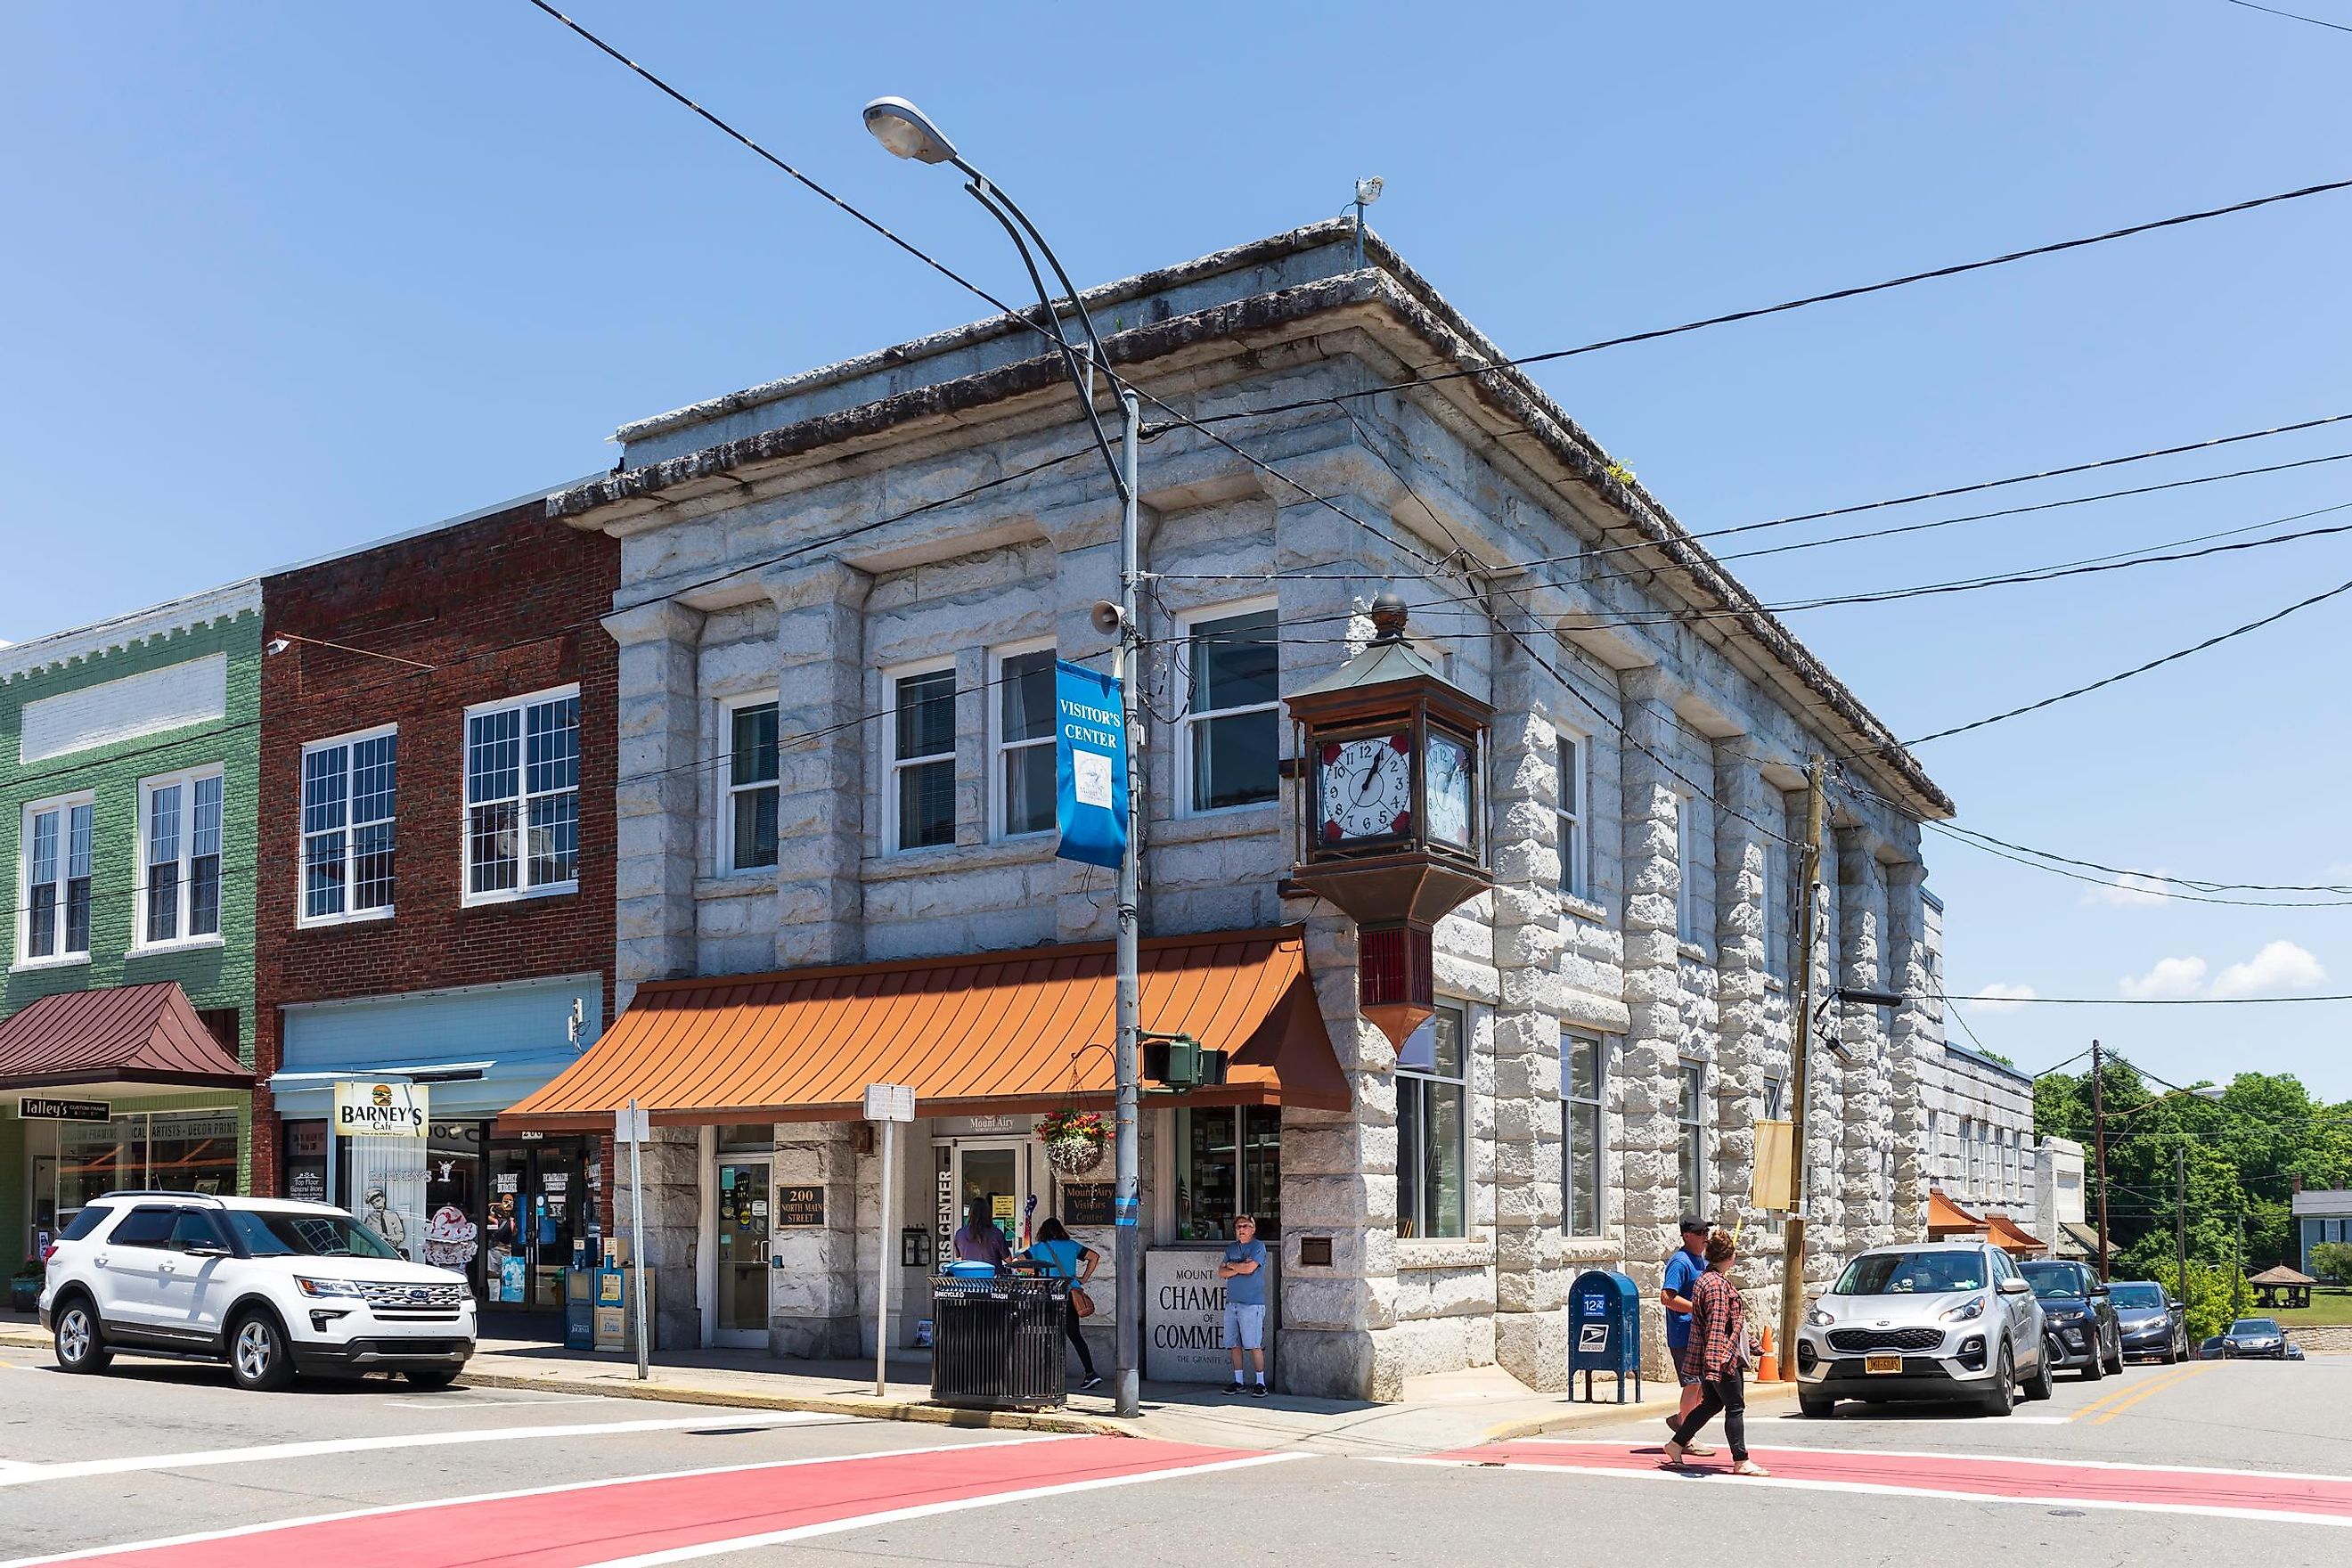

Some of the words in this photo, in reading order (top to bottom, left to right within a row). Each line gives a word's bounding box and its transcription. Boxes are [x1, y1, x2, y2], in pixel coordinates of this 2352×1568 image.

[1060, 698, 1121, 728] VISITOR'S
[1065, 723, 1117, 748] CENTER
[1346, 752, 1354, 765] 11
[1360, 745, 1372, 759] 12
[1390, 760, 1398, 772] 2
[1334, 766, 1345, 780] 10
[1395, 777, 1404, 791] 3
[1330, 786, 1339, 799] 9
[1391, 796, 1400, 809] 4
[1335, 803, 1343, 816] 8
[1347, 814, 1354, 828] 7
[1362, 817, 1371, 830] 6
[1379, 811, 1387, 824] 5
[24, 1099, 67, 1117] Talley's
[341, 1105, 422, 1126] BARNEY'S
[372, 1120, 394, 1131] Café
[970, 1117, 995, 1128] Mount
[997, 1116, 1013, 1129] Airy
[152, 1123, 181, 1138] ARTISTS
[188, 1123, 212, 1136] DECOR
[789, 1189, 814, 1202] 200
[1095, 1188, 1114, 1197] Airy
[781, 1203, 803, 1213] NORTH
[804, 1203, 823, 1212] MAIN
[938, 1171, 951, 1236] CENTER
[788, 1213, 814, 1223] STREET
[1076, 1213, 1105, 1221] Center
[1176, 1270, 1213, 1280] MOUNT
[1584, 1300, 1597, 1311] 12
[1203, 1313, 1214, 1322] OF
[1177, 1355, 1189, 1363] THE
[1193, 1355, 1221, 1365] GRANITE
